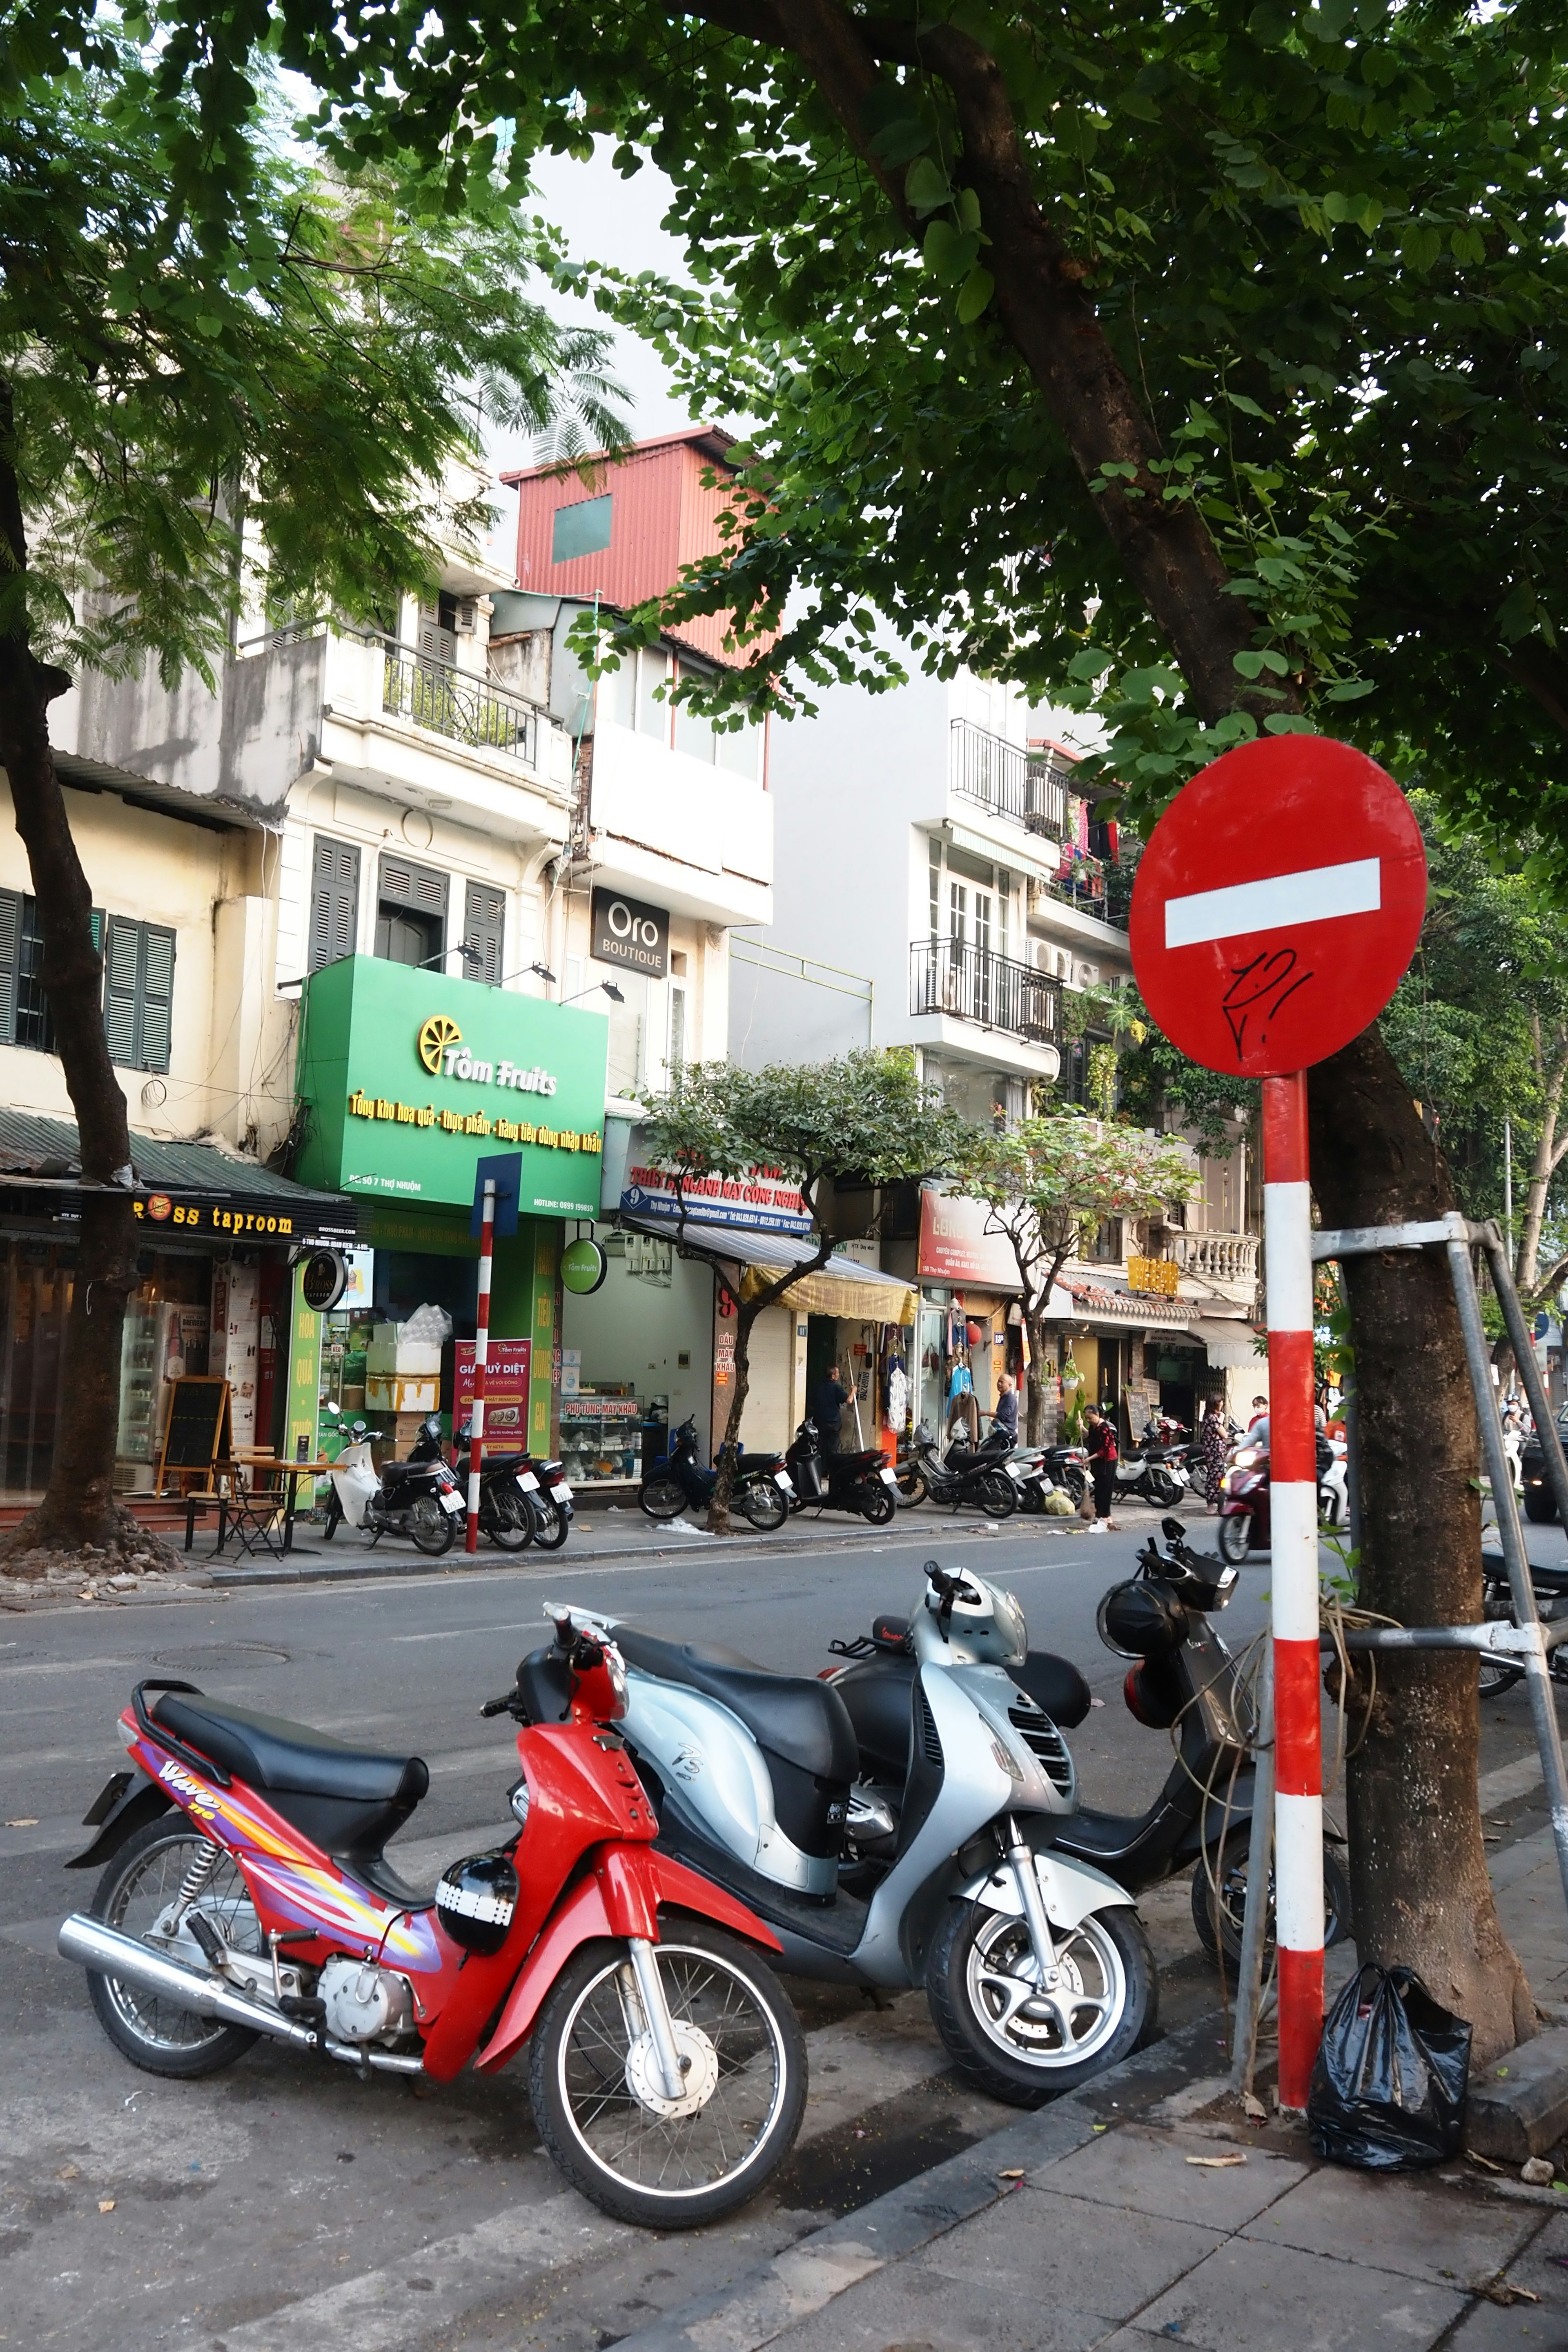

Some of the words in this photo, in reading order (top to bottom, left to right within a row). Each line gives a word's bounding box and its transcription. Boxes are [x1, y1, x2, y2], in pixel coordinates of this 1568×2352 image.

[608, 902, 658, 947] Oro
[603, 939, 662, 968] BOUTIQUE
[443, 1047, 493, 1082] Tôm
[497, 1060, 557, 1096] Fruits
[349, 1089, 374, 1119] Tổng
[374, 1099, 395, 1120] kho
[395, 1102, 415, 1123] hoa
[415, 1104, 434, 1127] quả
[441, 1110, 463, 1133] thực
[463, 1110, 490, 1135] phẩm
[518, 1123, 536, 1143] tiêu
[558, 1131, 579, 1152] nhập
[579, 1131, 601, 1152] khẩu
[374, 1178, 379, 1186] 7
[381, 1178, 395, 1191] THỢ
[396, 1180, 421, 1193] NHUỘM
[630, 1188, 640, 1205] 9
[534, 1198, 559, 1208] HOTLINE:
[560, 1201, 574, 1210] 0899
[575, 1203, 593, 1212] 199859
[213, 1206, 292, 1234] taproom
[318, 1226, 356, 1235] BROSSBEER.COM
[568, 1262, 580, 1271] Tôm
[298, 1312, 315, 1339] HOA
[296, 1350, 313, 1388] QUẢ
[503, 1363, 526, 1376] DIỆT
[565, 1403, 580, 1417] PHỤ
[581, 1401, 600, 1415] TÙNG
[602, 1402, 617, 1415] MÁY
[618, 1402, 637, 1415] KHÂU
[158, 1761, 221, 1809] Wave
[187, 1802, 216, 1820] 110
